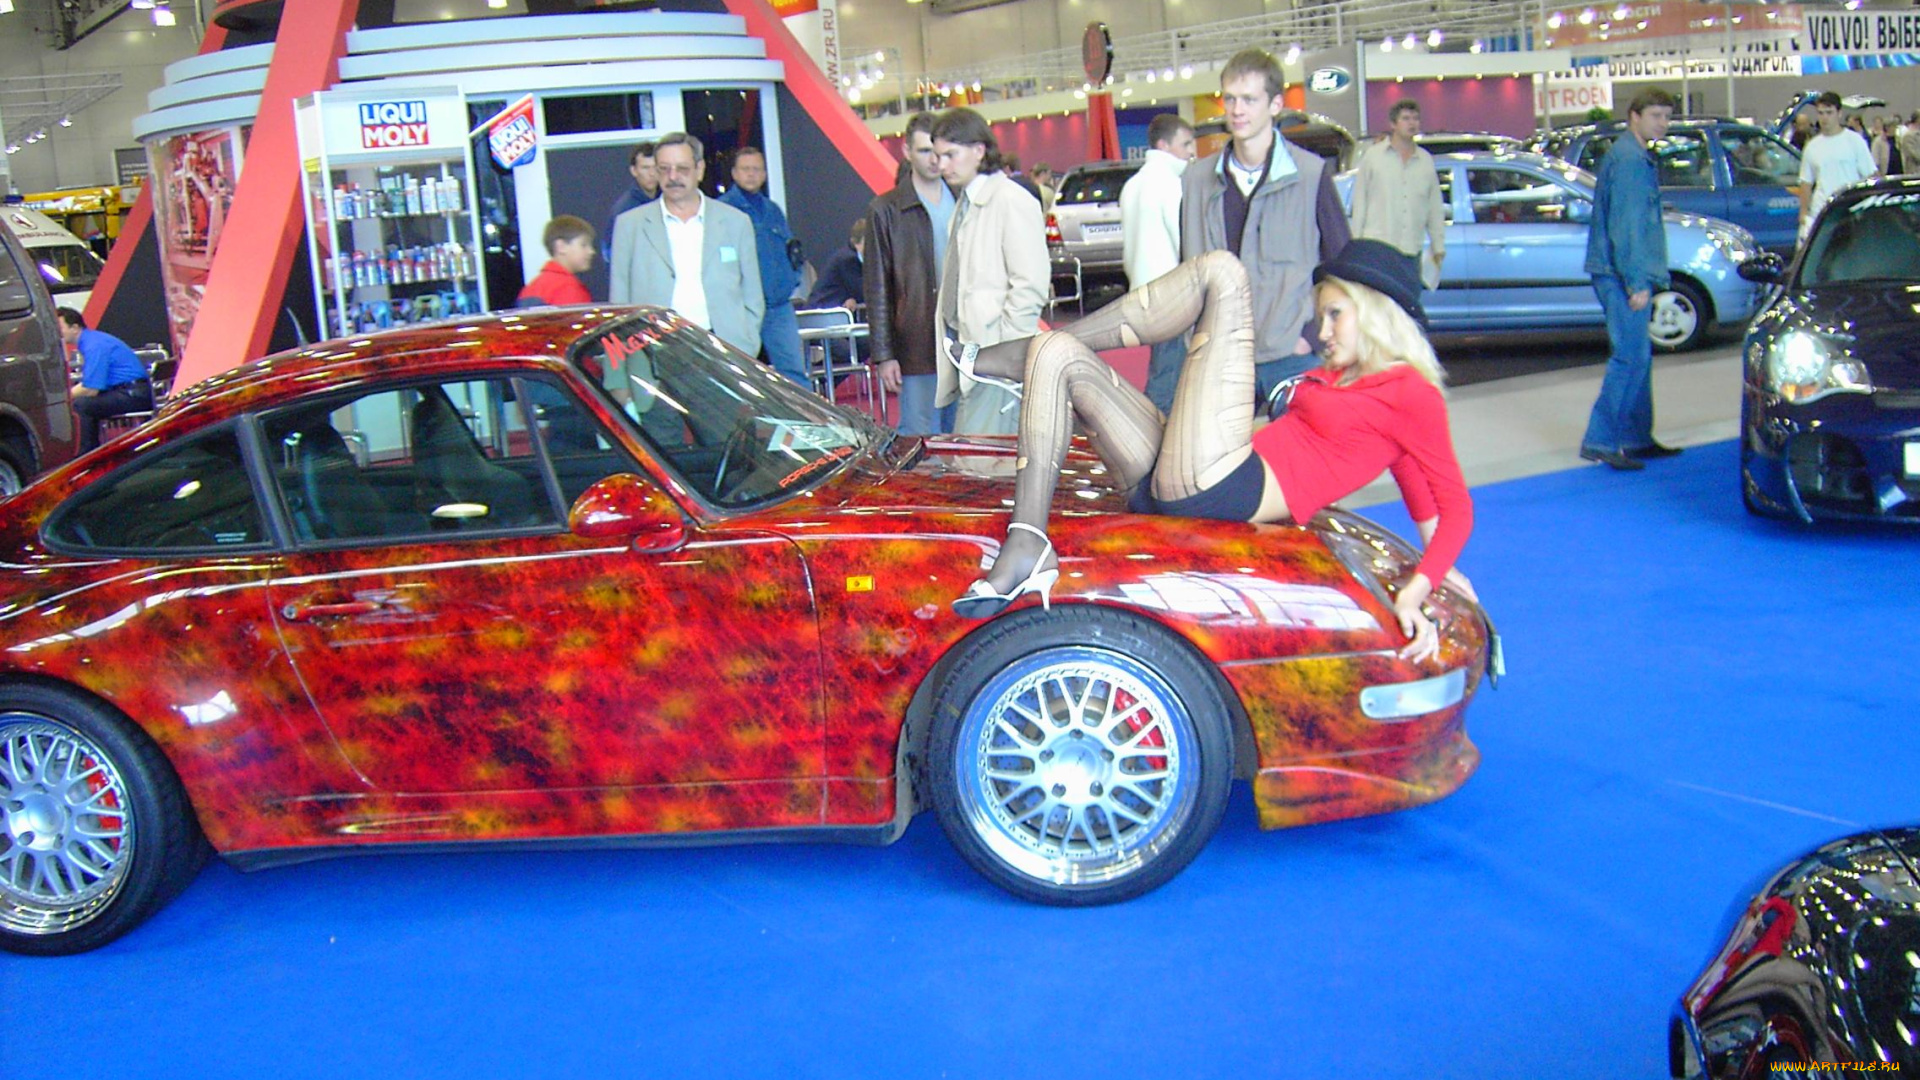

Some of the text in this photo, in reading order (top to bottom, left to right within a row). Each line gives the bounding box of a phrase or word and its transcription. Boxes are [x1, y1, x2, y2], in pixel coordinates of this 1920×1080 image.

[1808, 16, 1869, 50] VOLVO!
[360, 103, 426, 125] LIQUI
[362, 124, 428, 148] MOLY
[490, 117, 530, 151] LIQUI
[499, 130, 536, 163] MOLY
